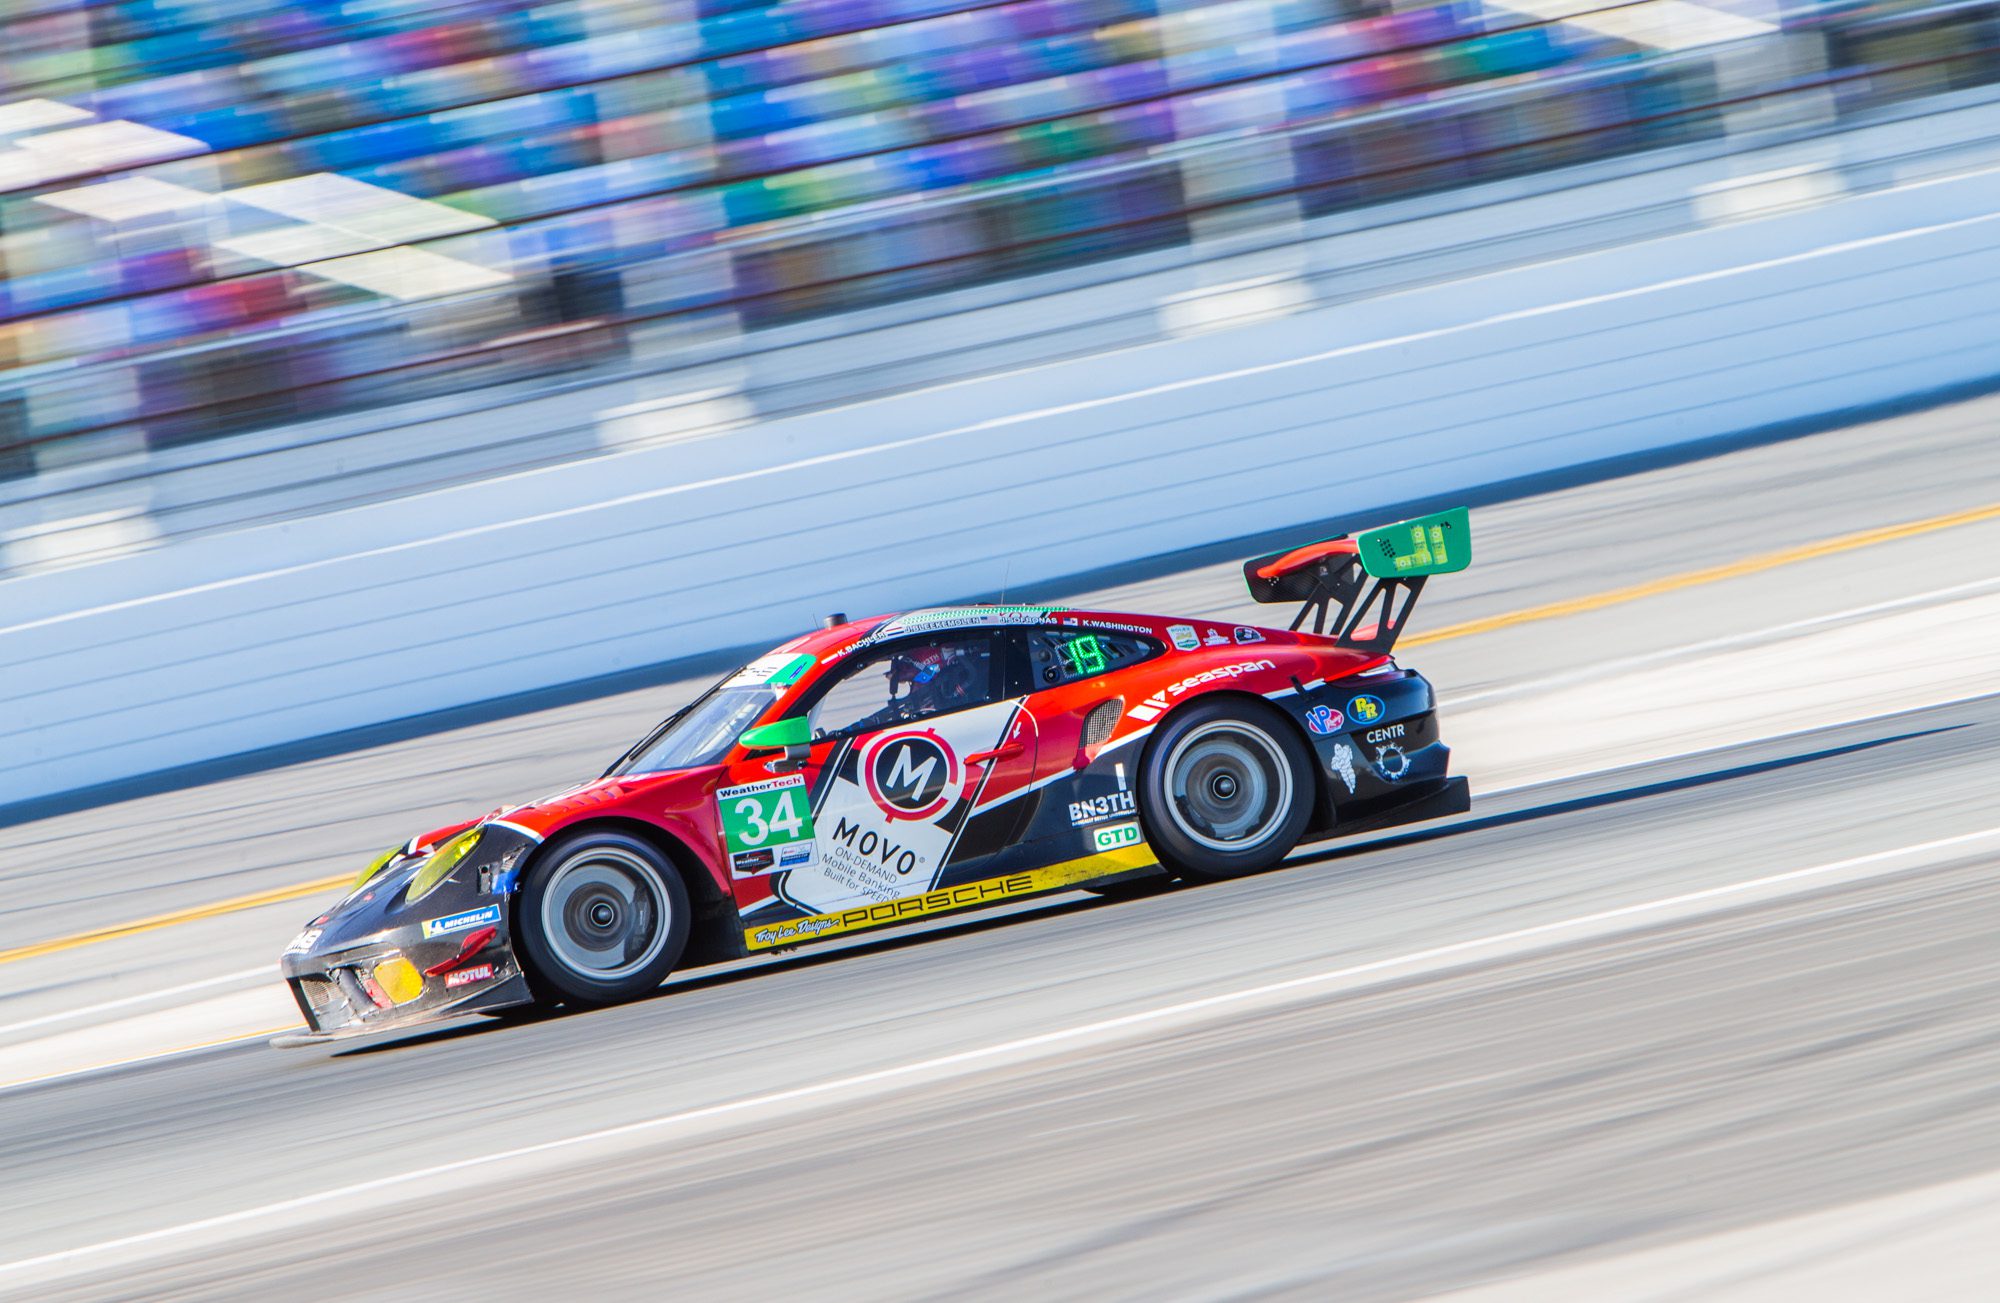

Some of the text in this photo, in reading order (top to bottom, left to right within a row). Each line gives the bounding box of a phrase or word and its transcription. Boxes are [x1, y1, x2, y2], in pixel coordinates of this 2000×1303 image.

[1082, 620, 1153, 635] K.WASHINGTON
[1068, 636, 1103, 675] 19
[1167, 660, 1276, 697] seaspan
[1367, 724, 1405, 743] CENTR
[720, 778, 801, 798] WeatherTech
[735, 791, 803, 845] 34
[1068, 790, 1135, 821] BN3TH
[832, 816, 915, 875] MOVO
[1097, 827, 1138, 846] GTD
[822, 853, 900, 899] Mobile Banking
[824, 867, 844, 884] Built
[846, 878, 860, 891] for
[835, 847, 897, 884] ON-DEMAND
[842, 876, 1033, 927] PORSCHE
[444, 911, 493, 928] MICHELIN
[755, 919, 840, 944] Troy Lee Designs
[448, 967, 491, 985] MOTUL
